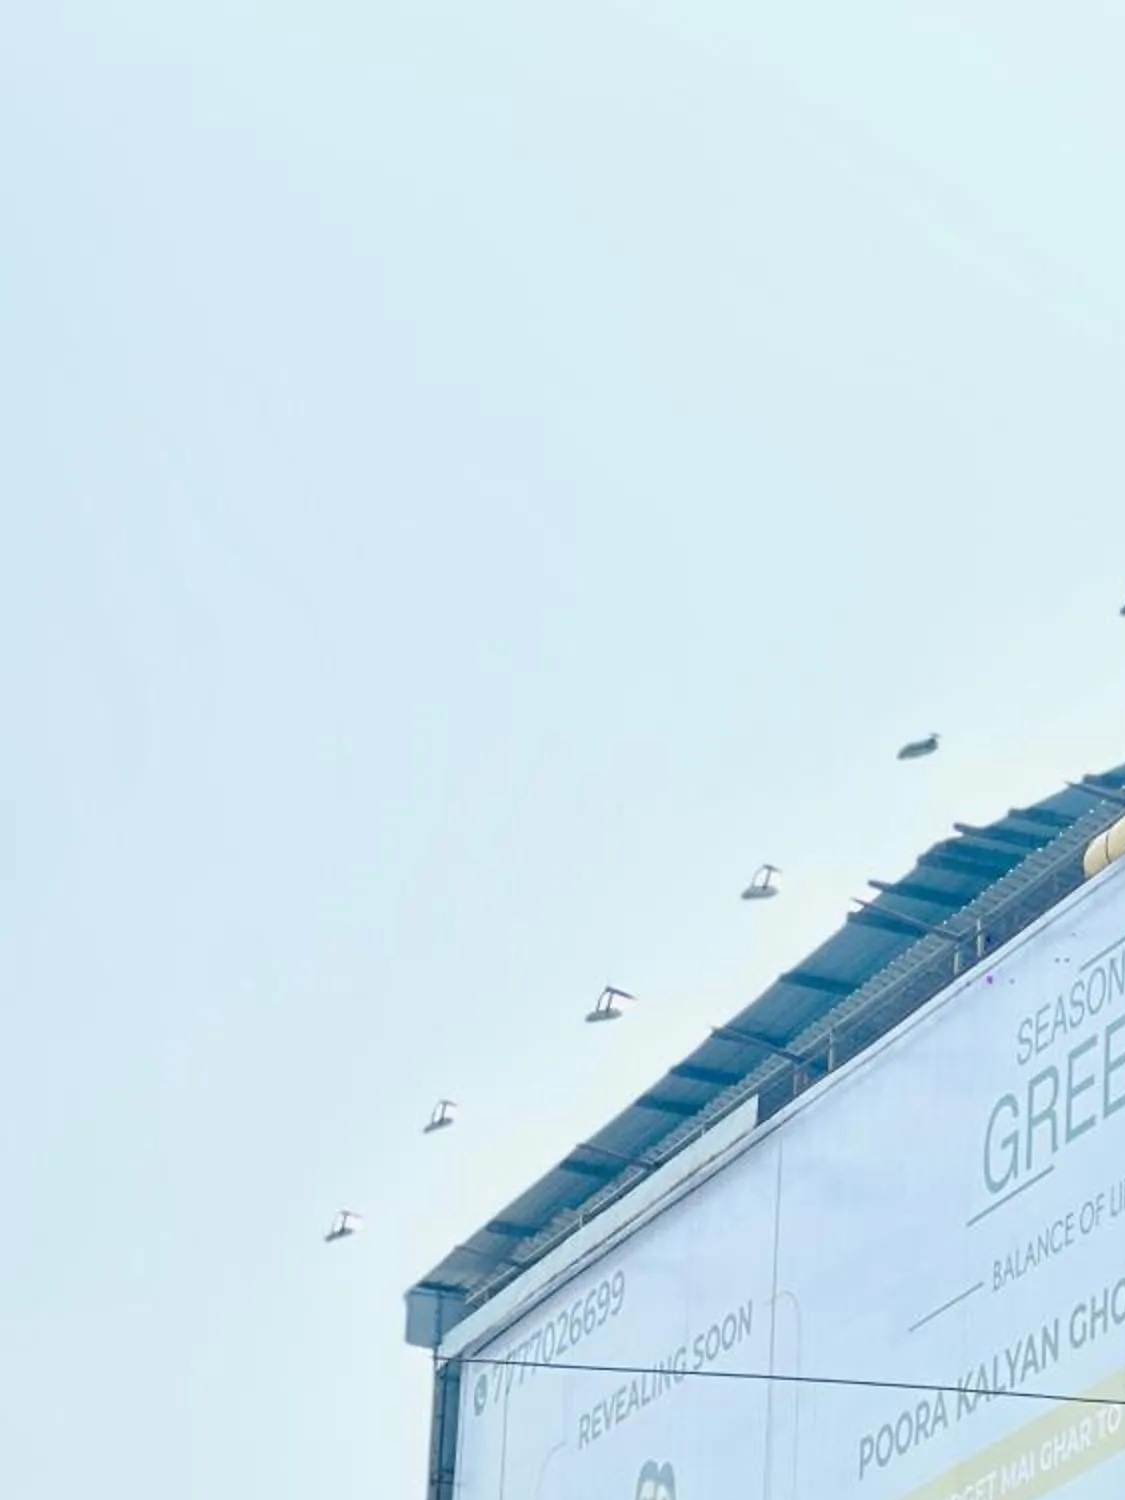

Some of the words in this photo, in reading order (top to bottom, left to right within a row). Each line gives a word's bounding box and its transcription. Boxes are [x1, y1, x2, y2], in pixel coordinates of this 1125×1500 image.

[991, 1212, 1075, 1293] BALANCE
[1079, 1194, 1106, 1236] OF
[578, 1347, 688, 1451] REVEALING
[693, 1300, 754, 1371] SOON
[857, 1390, 949, 1482] POORA
[955, 1317, 1060, 1423] KALYAN
[1000, 1450, 1036, 1498] MAI
[1039, 1416, 1095, 1472] GHAR
[1097, 1402, 1122, 1441] TO
